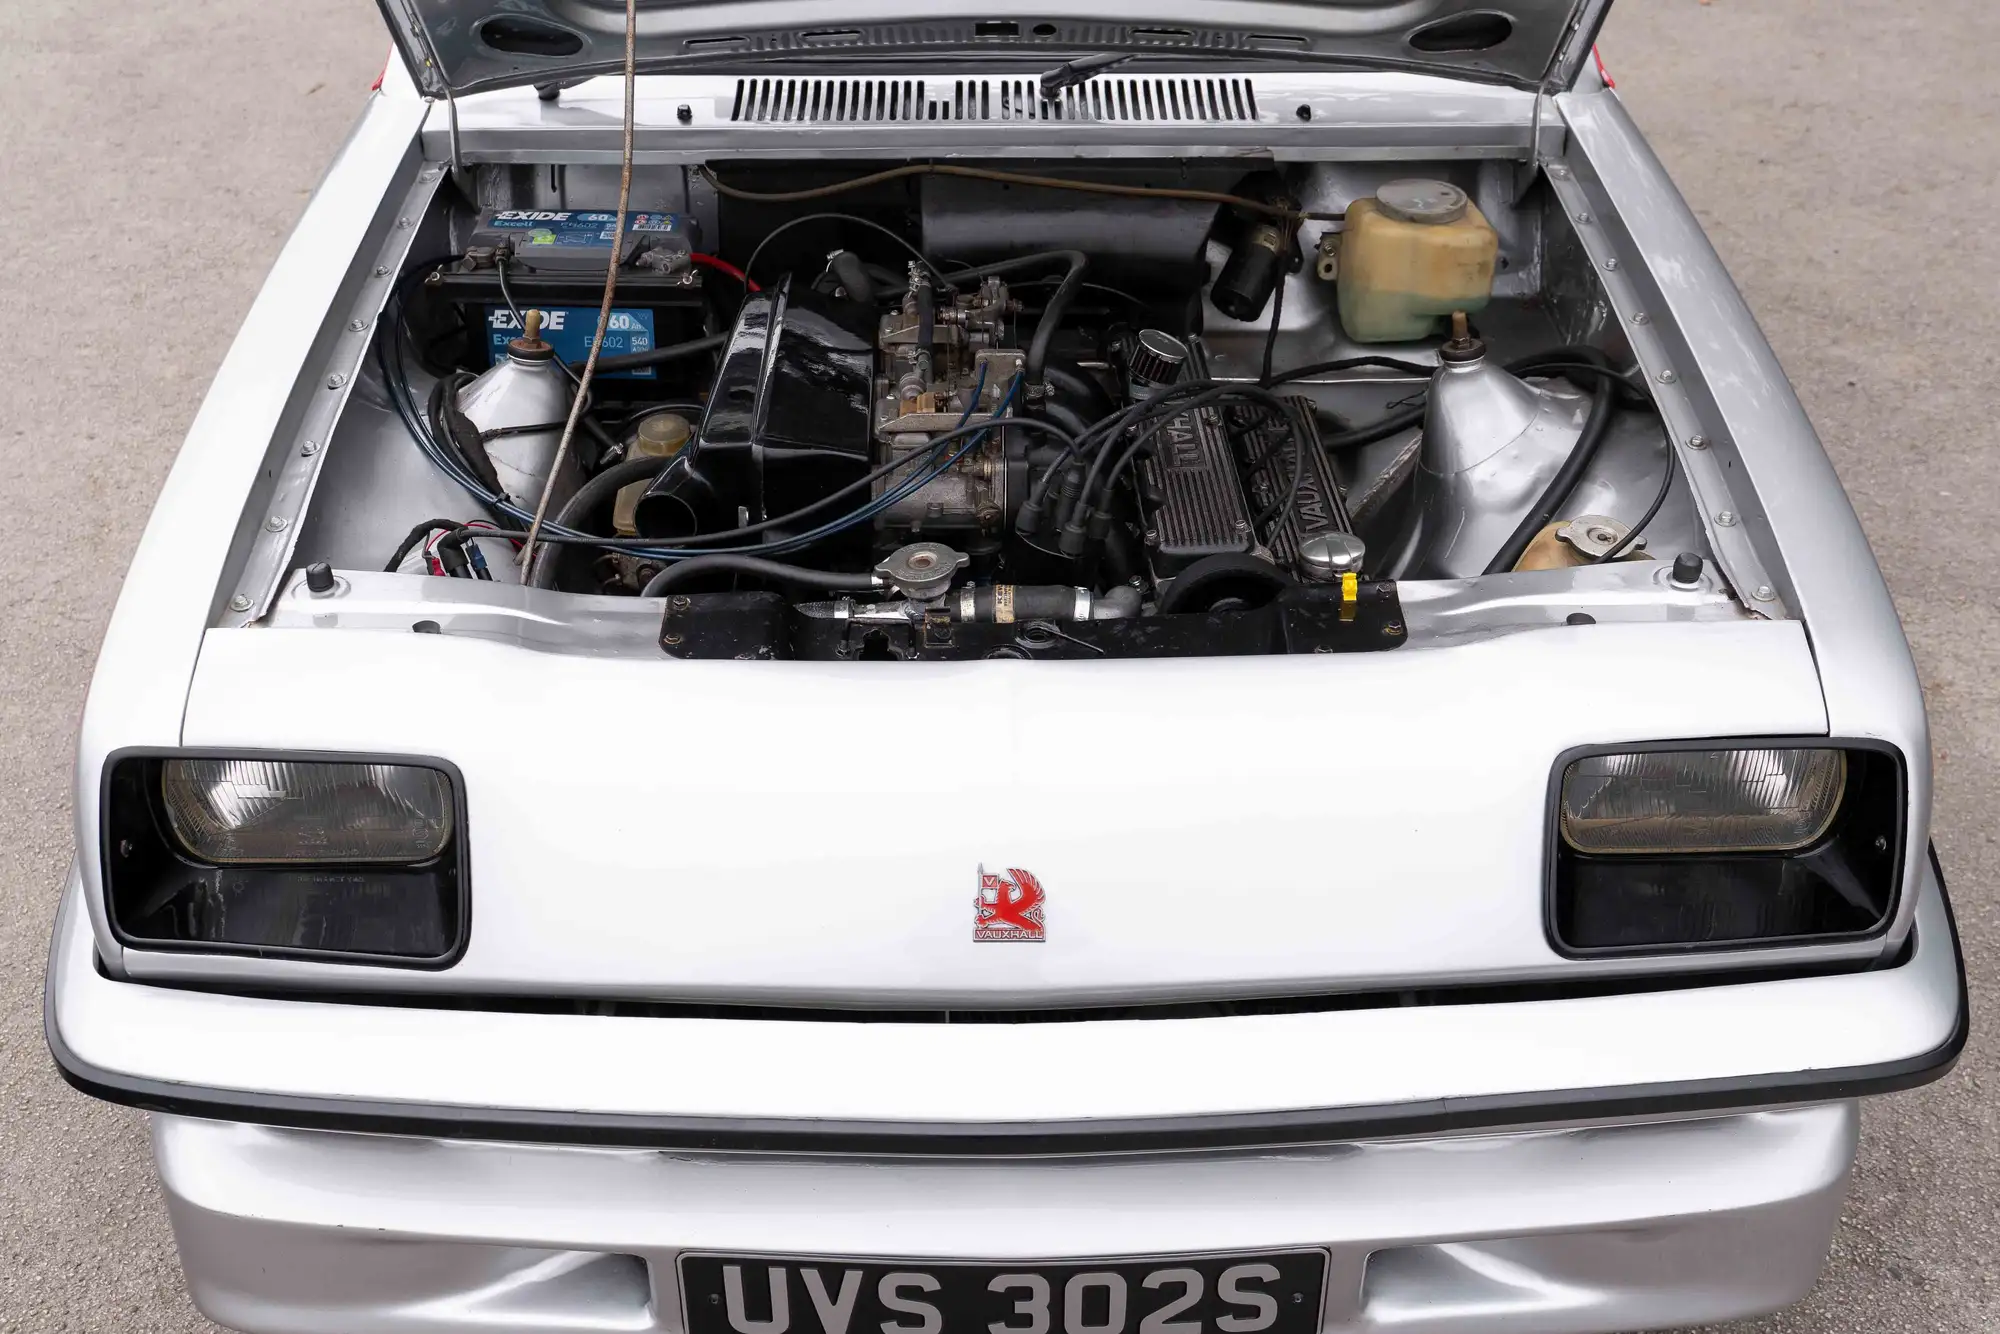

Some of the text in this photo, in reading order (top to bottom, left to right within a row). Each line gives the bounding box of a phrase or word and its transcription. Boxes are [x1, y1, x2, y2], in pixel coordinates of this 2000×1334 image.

[495, 210, 572, 221] EXIDE
[587, 213, 608, 221] 60
[488, 309, 566, 330] EXDE
[609, 314, 630, 329] 60
[584, 335, 624, 348] E602
[631, 336, 648, 346] 540
[983, 876, 996, 886] V
[976, 930, 1043, 939] VAUXHALL
[722, 1263, 1281, 1334] UVS 302S
